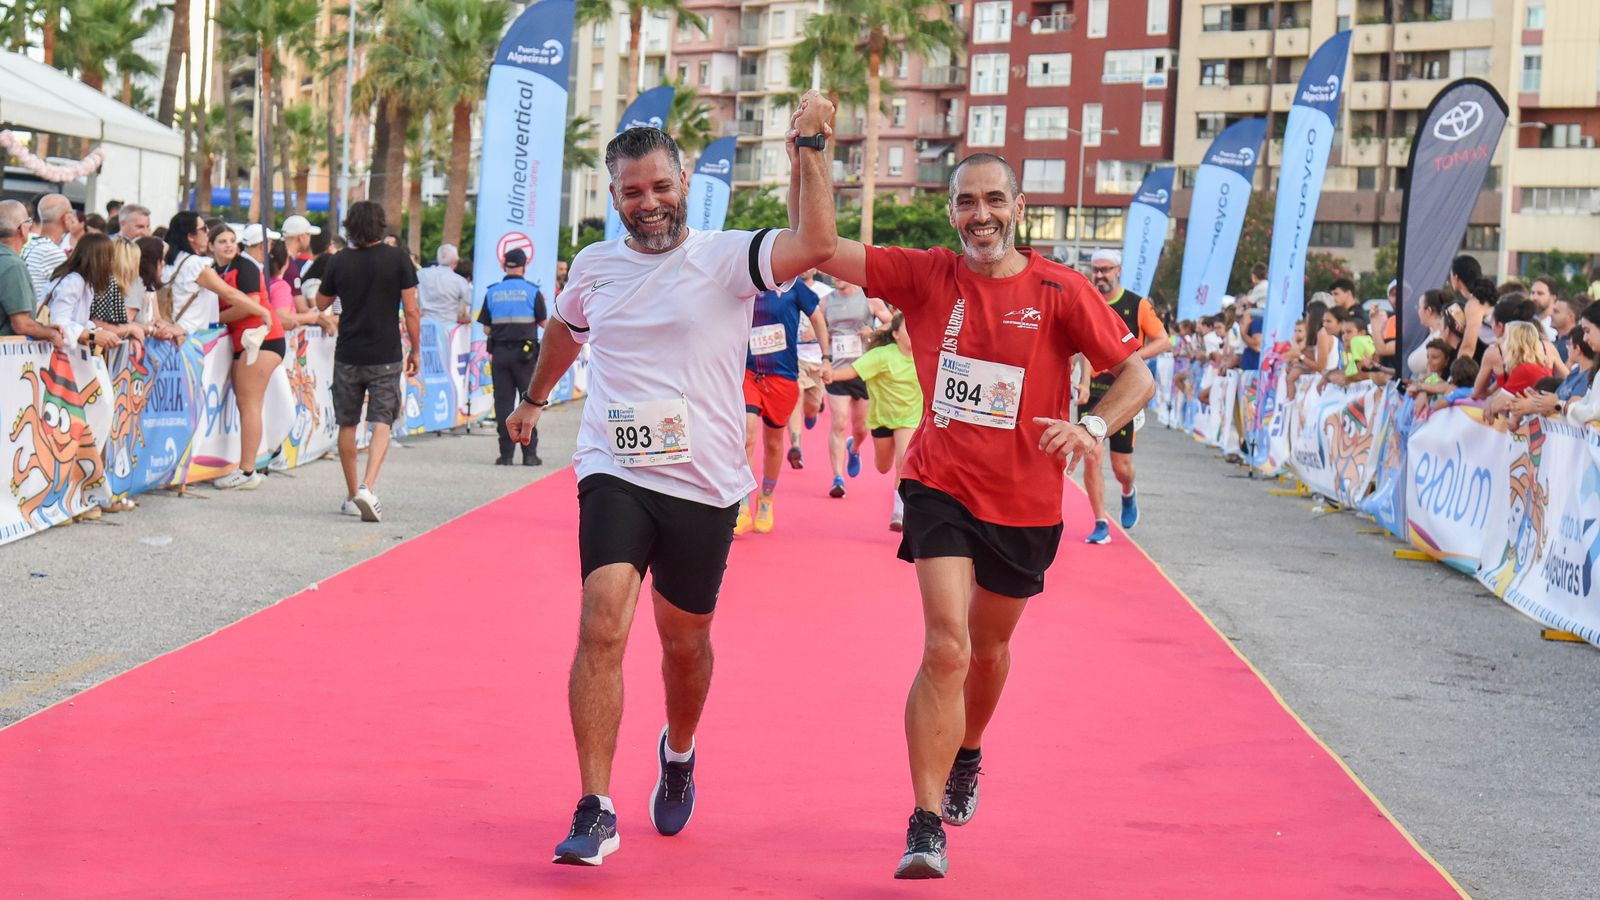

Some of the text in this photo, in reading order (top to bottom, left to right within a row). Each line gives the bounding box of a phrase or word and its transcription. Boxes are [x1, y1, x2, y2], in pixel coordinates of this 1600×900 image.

[517, 45, 540, 54] Puerto
[507, 51, 550, 65] Algeciras
[944, 298, 966, 337] BARRIOS
[836, 343, 845, 351] 61
[943, 357, 956, 370] XXI
[945, 377, 982, 406] 894
[608, 409, 620, 419] XXI
[615, 425, 652, 449] 893
